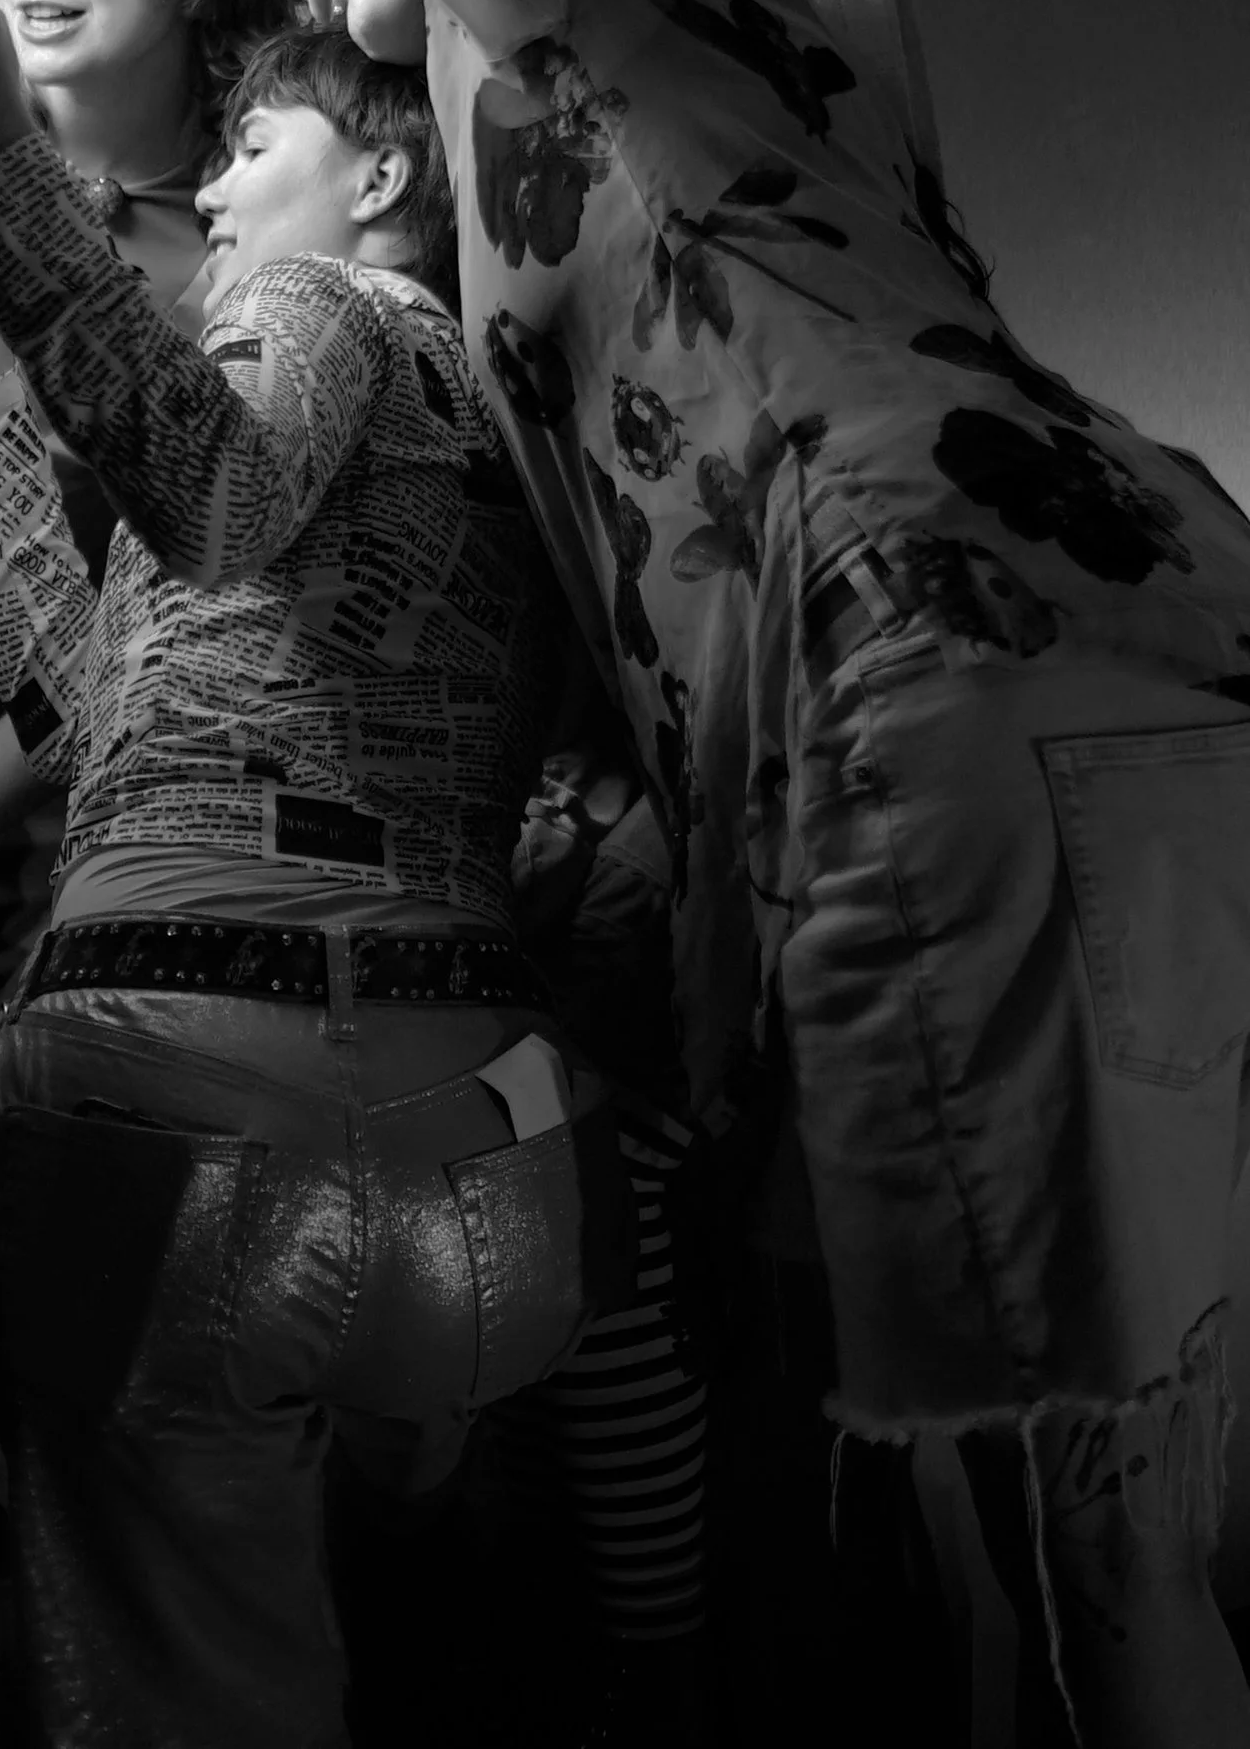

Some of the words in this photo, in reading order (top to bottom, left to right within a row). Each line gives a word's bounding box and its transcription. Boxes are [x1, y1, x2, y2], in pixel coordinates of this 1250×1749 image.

[2, 457, 21, 476] TOP
[19, 474, 46, 500] STORY
[6, 487, 35, 516] YOU
[13, 546, 47, 575] GOOD
[188, 714, 219, 729] gone
[235, 718, 265, 742] what
[269, 734, 301, 758] than
[303, 752, 342, 780] better
